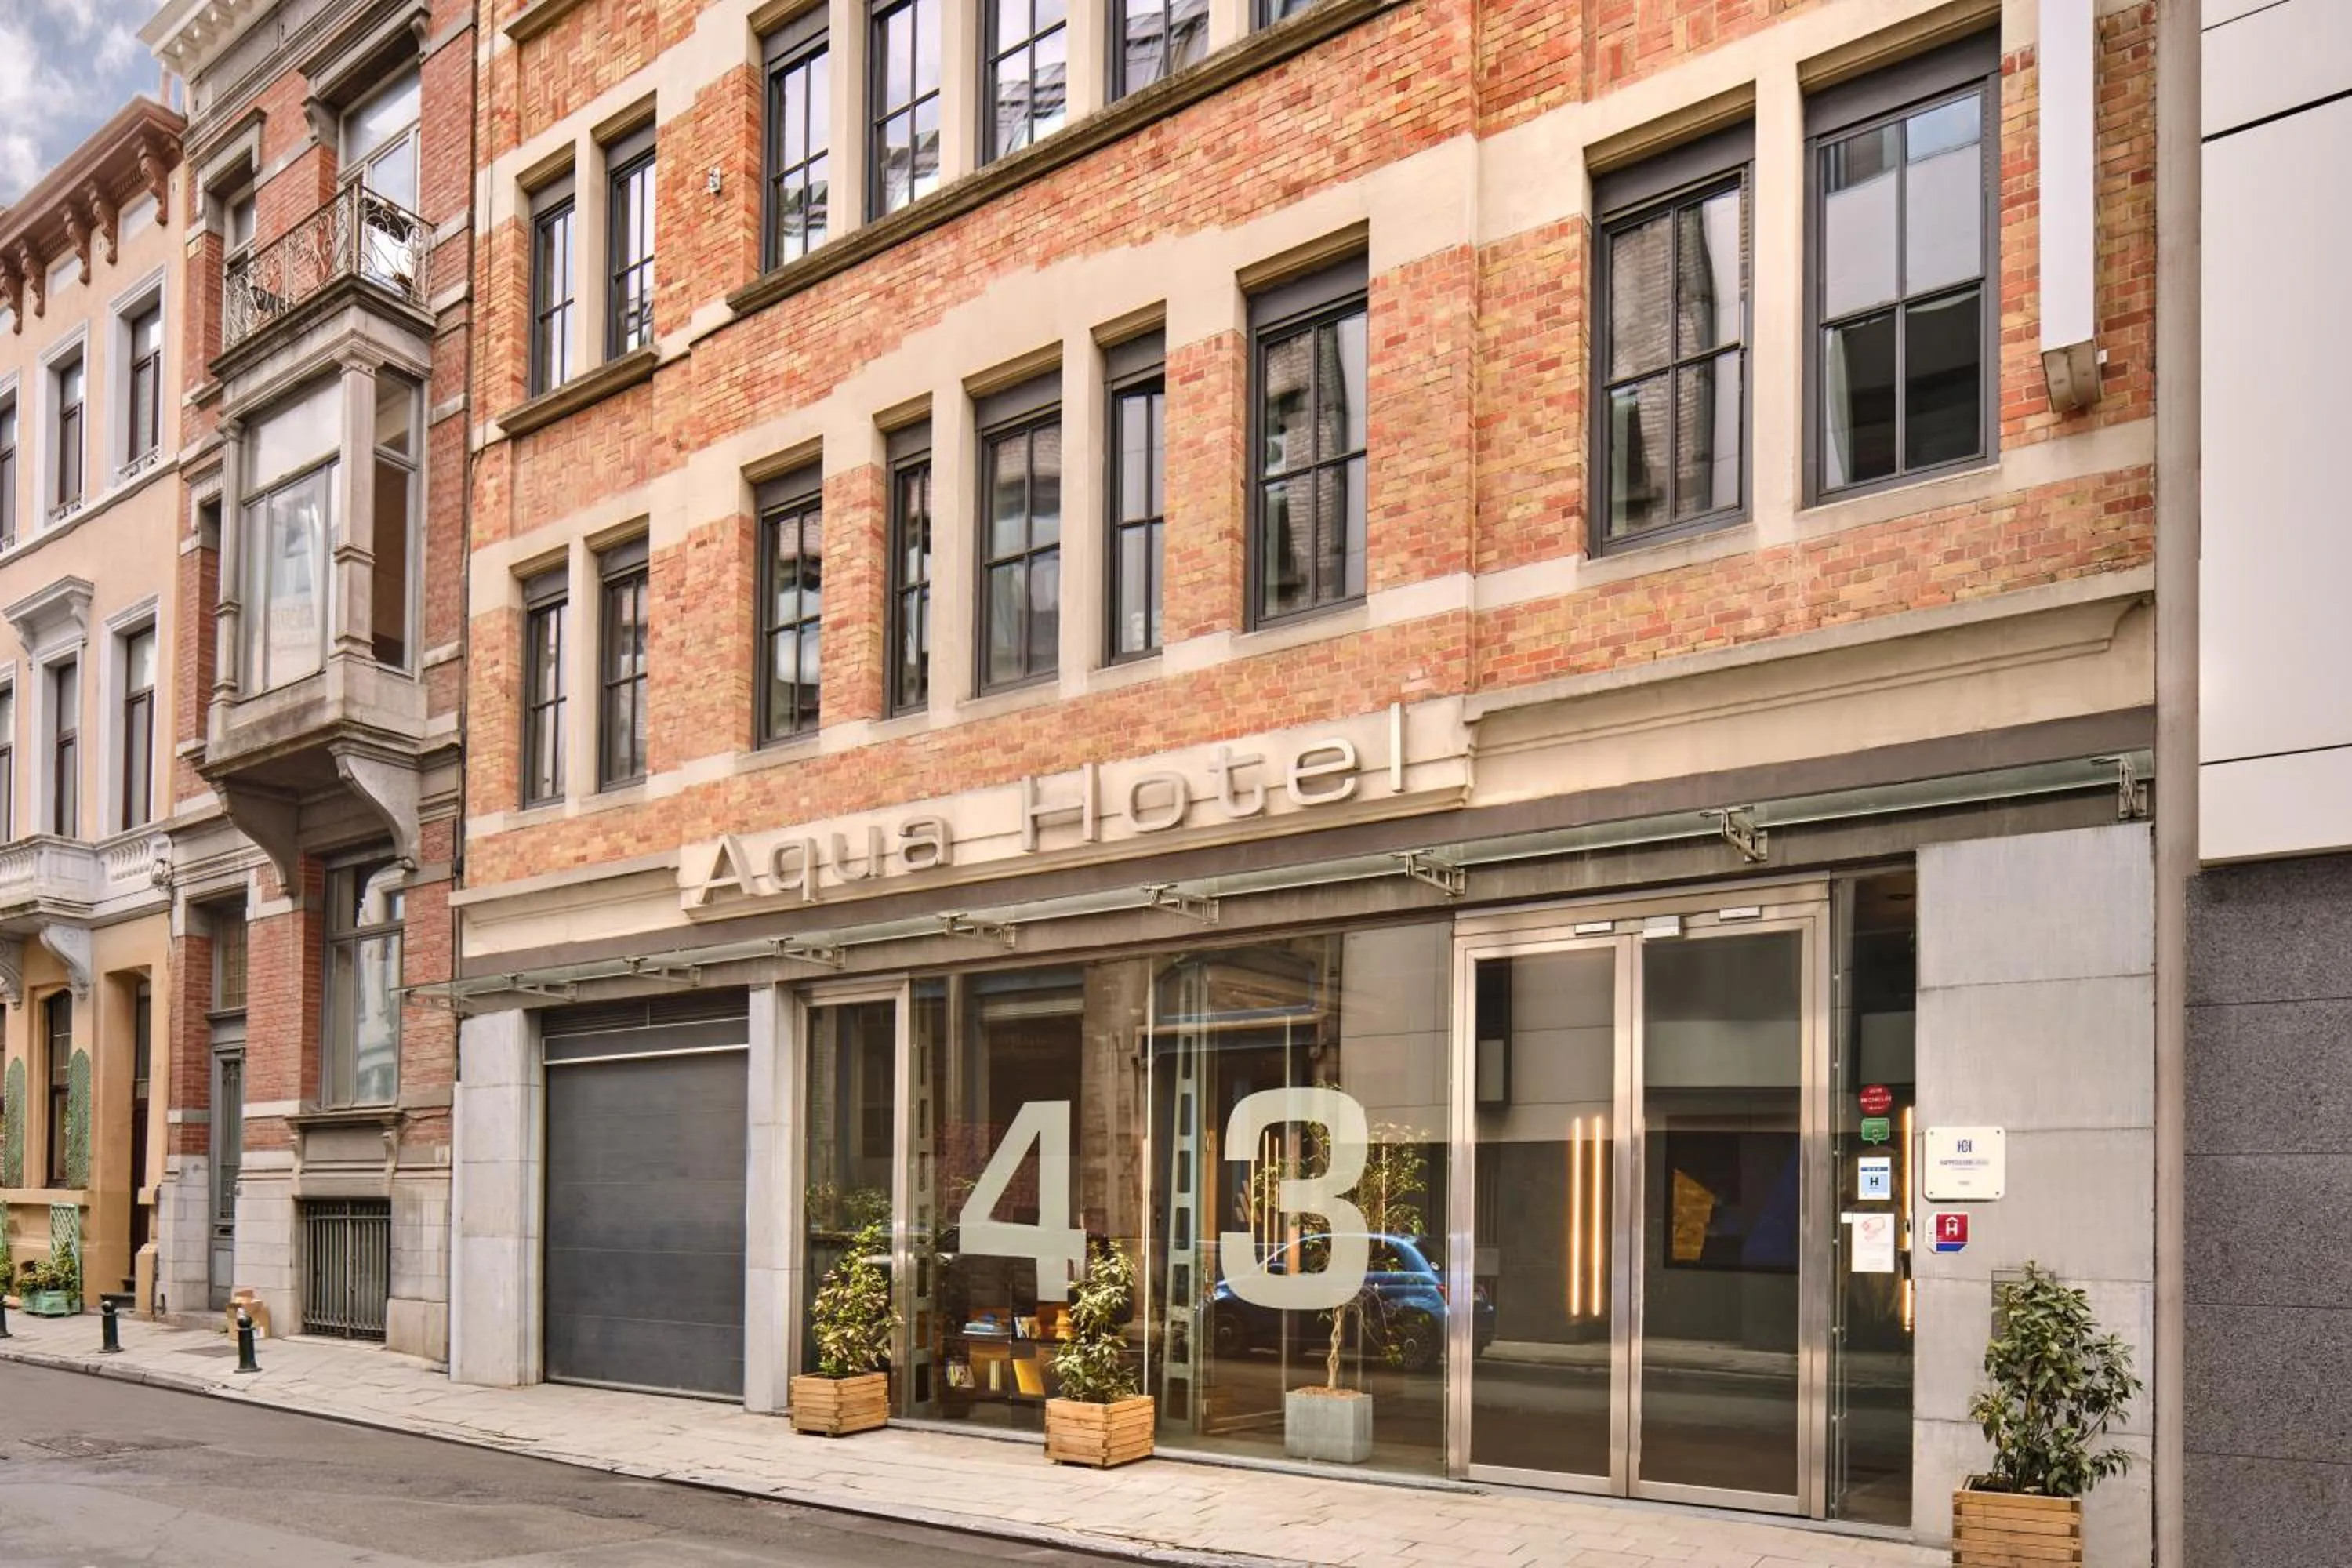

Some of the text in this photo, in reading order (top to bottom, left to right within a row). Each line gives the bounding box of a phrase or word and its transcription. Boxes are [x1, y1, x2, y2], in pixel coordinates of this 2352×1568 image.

[696, 702, 1408, 905] Aqua Hotel
[959, 1087, 1369, 1310] 43
